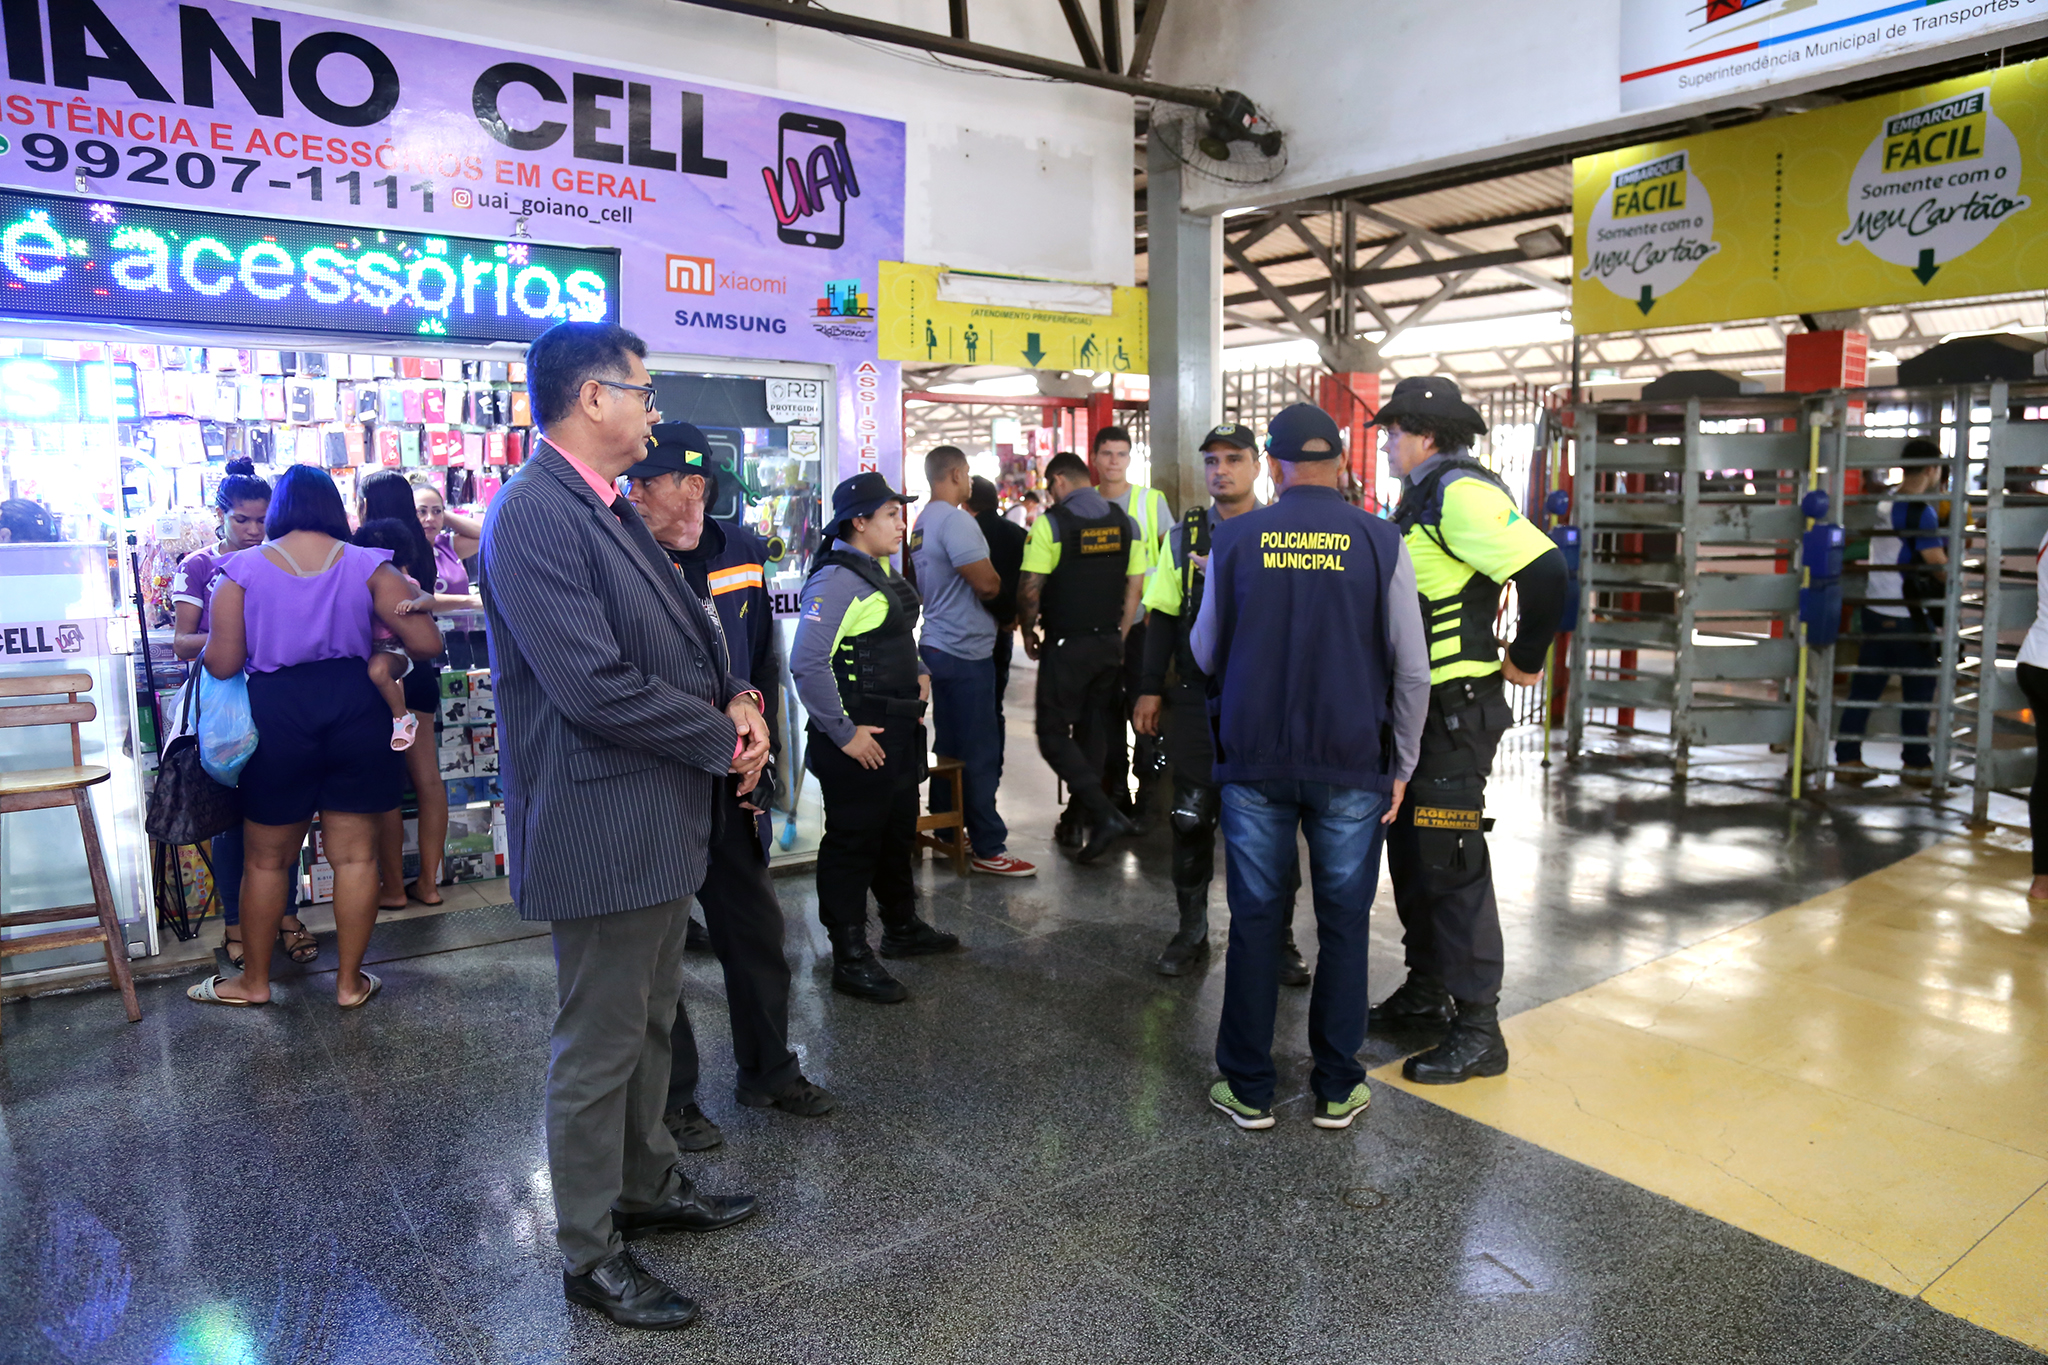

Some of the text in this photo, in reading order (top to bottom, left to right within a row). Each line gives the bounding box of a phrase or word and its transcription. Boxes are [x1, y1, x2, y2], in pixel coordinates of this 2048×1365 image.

[1678, 0, 2019, 89] Superintendência Municipal de Transportes
[471, 61, 727, 178] CELL
[1891, 97, 1978, 134] EMBARQUE
[0, 94, 656, 203] STÊNCIA E ACESSÓRIOS EM GERAL
[1885, 125, 1980, 170] FÁCIL
[21, 132, 434, 213] 99207-1111
[761, 138, 860, 226] UAI
[1618, 157, 1682, 187] EMBARQUE
[1861, 166, 2007, 200] Somente com o
[478, 192, 632, 224] uai_goiano_cell
[1614, 181, 1684, 216] FÁCIL
[1842, 191, 2024, 242] Meu Cartão
[1597, 216, 1703, 241] Somente com o
[110, 224, 608, 323] acessórios
[1583, 237, 1717, 277] Meu Cartão
[719, 270, 787, 294] xiaomi
[675, 309, 787, 334] SAMSUNG
[1260, 531, 1351, 551] POLICIAMENTO
[1263, 552, 1345, 571] MUNICIPAL
[1418, 809, 1476, 820] AGENTE
